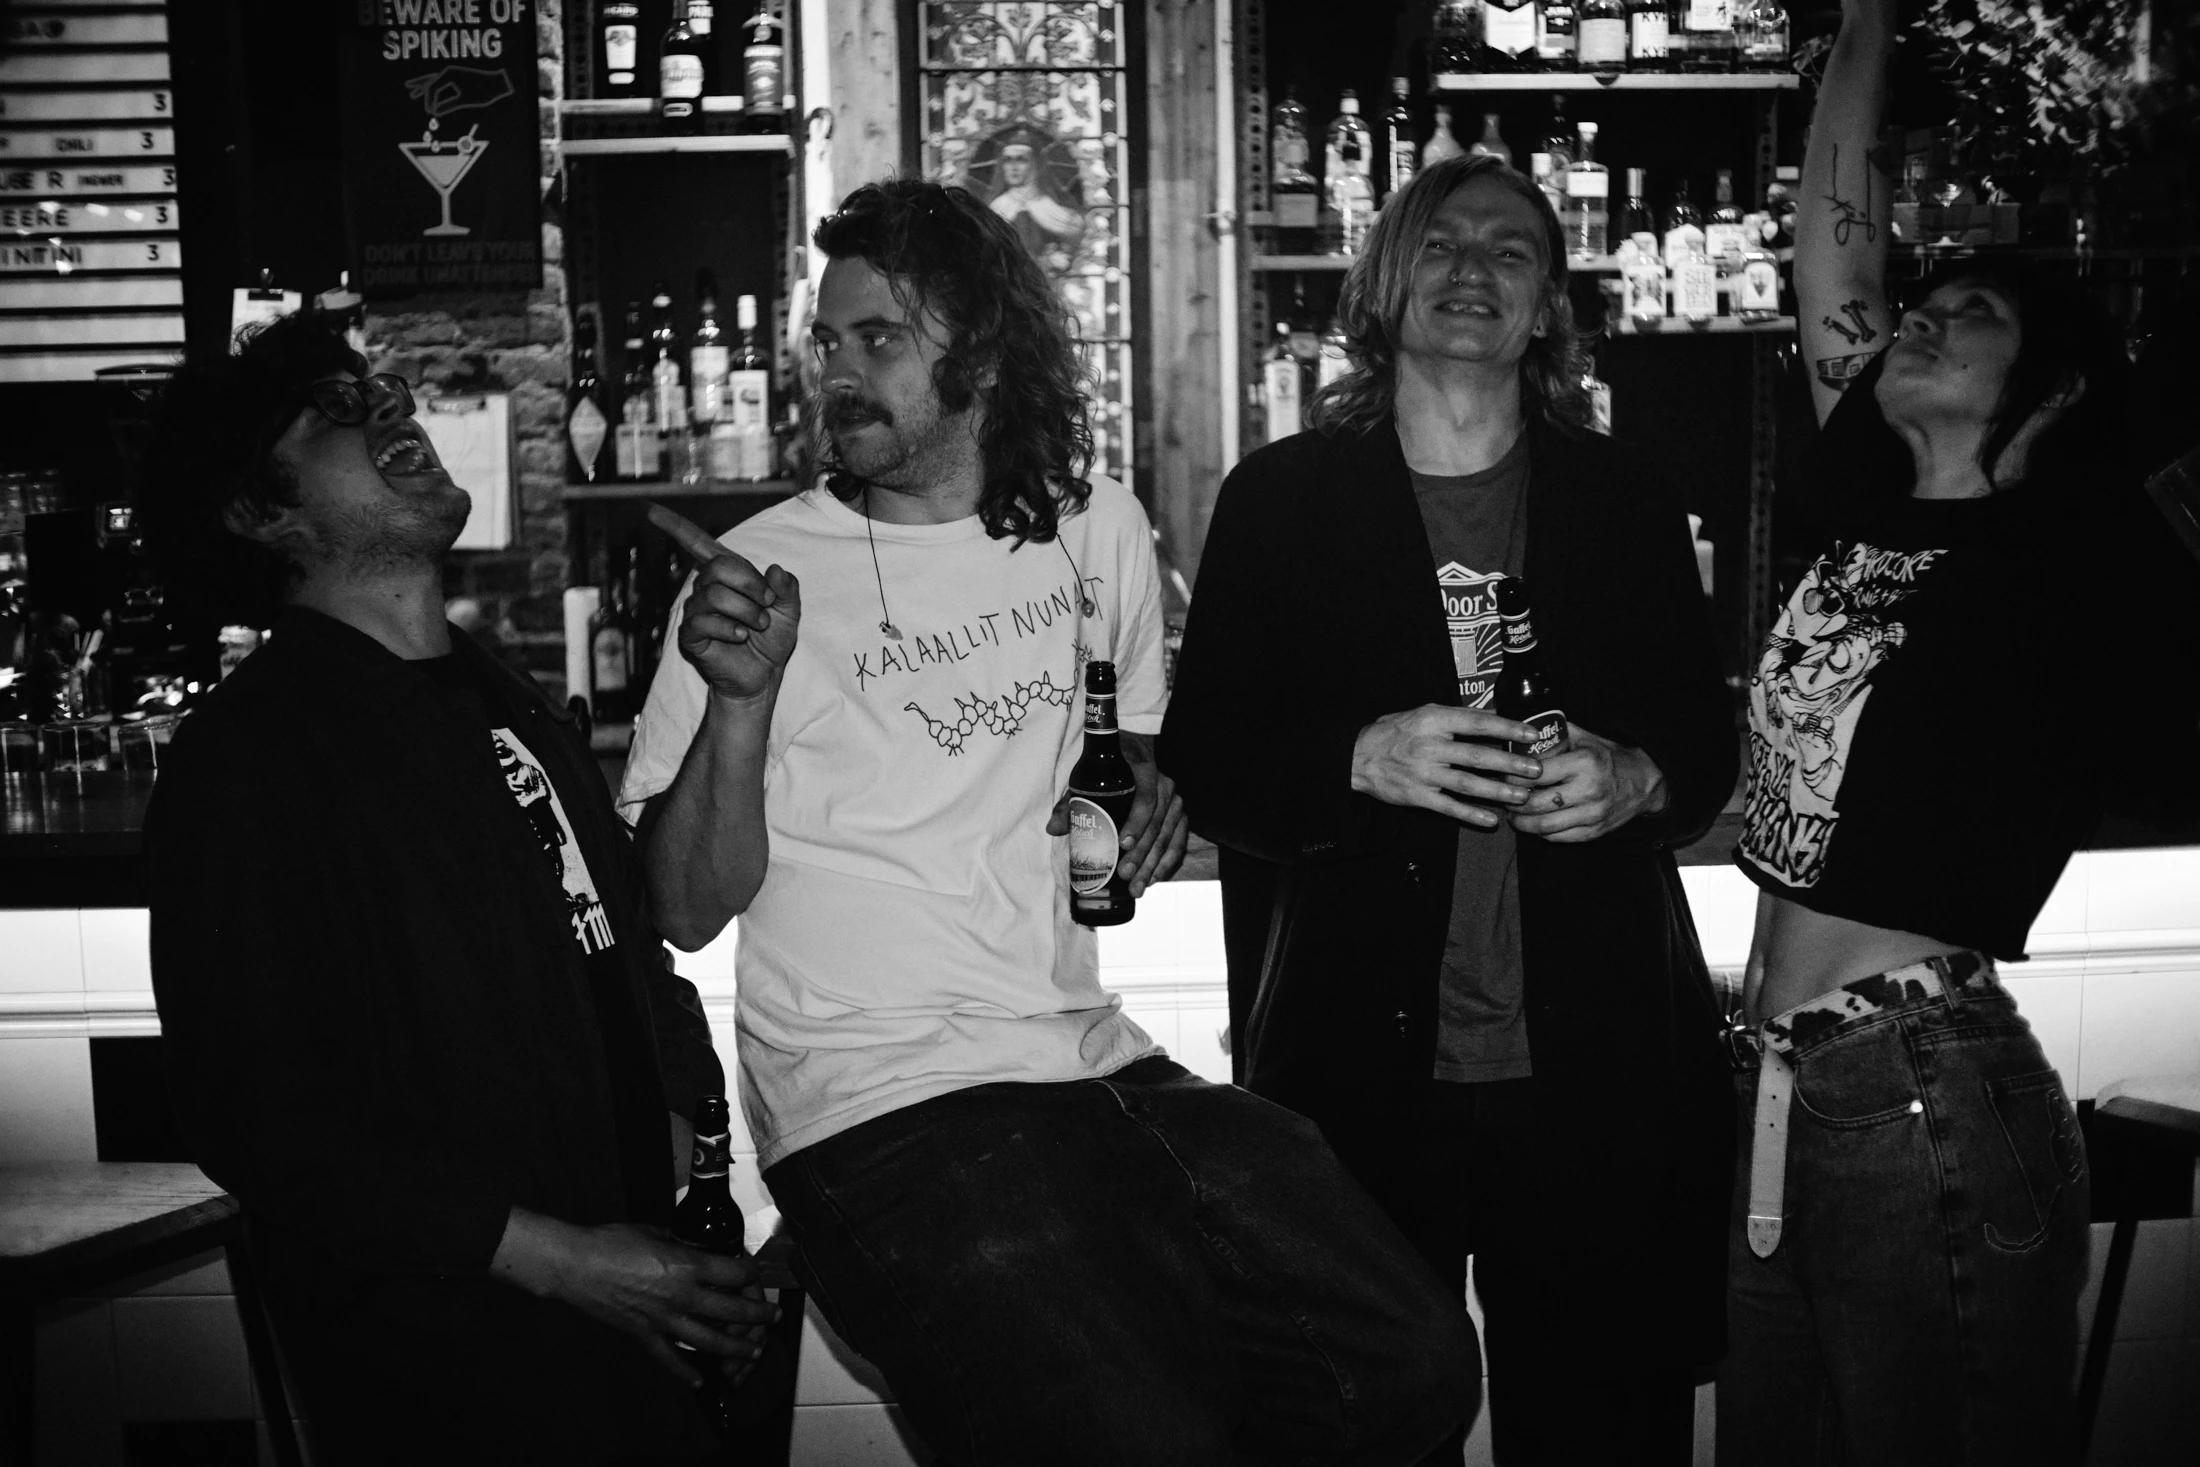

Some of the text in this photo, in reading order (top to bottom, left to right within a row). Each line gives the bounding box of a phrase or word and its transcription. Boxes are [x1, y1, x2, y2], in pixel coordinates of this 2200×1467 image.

[360, 0, 526, 25] BEWARE OF
[382, 28, 502, 60] SPIKING
[154, 93, 167, 111] 3
[141, 132, 154, 149] 3
[163, 169, 176, 186] 3
[156, 206, 168, 224] 3
[147, 244, 160, 261] 3
[854, 612, 1000, 692] KALAALLIT
